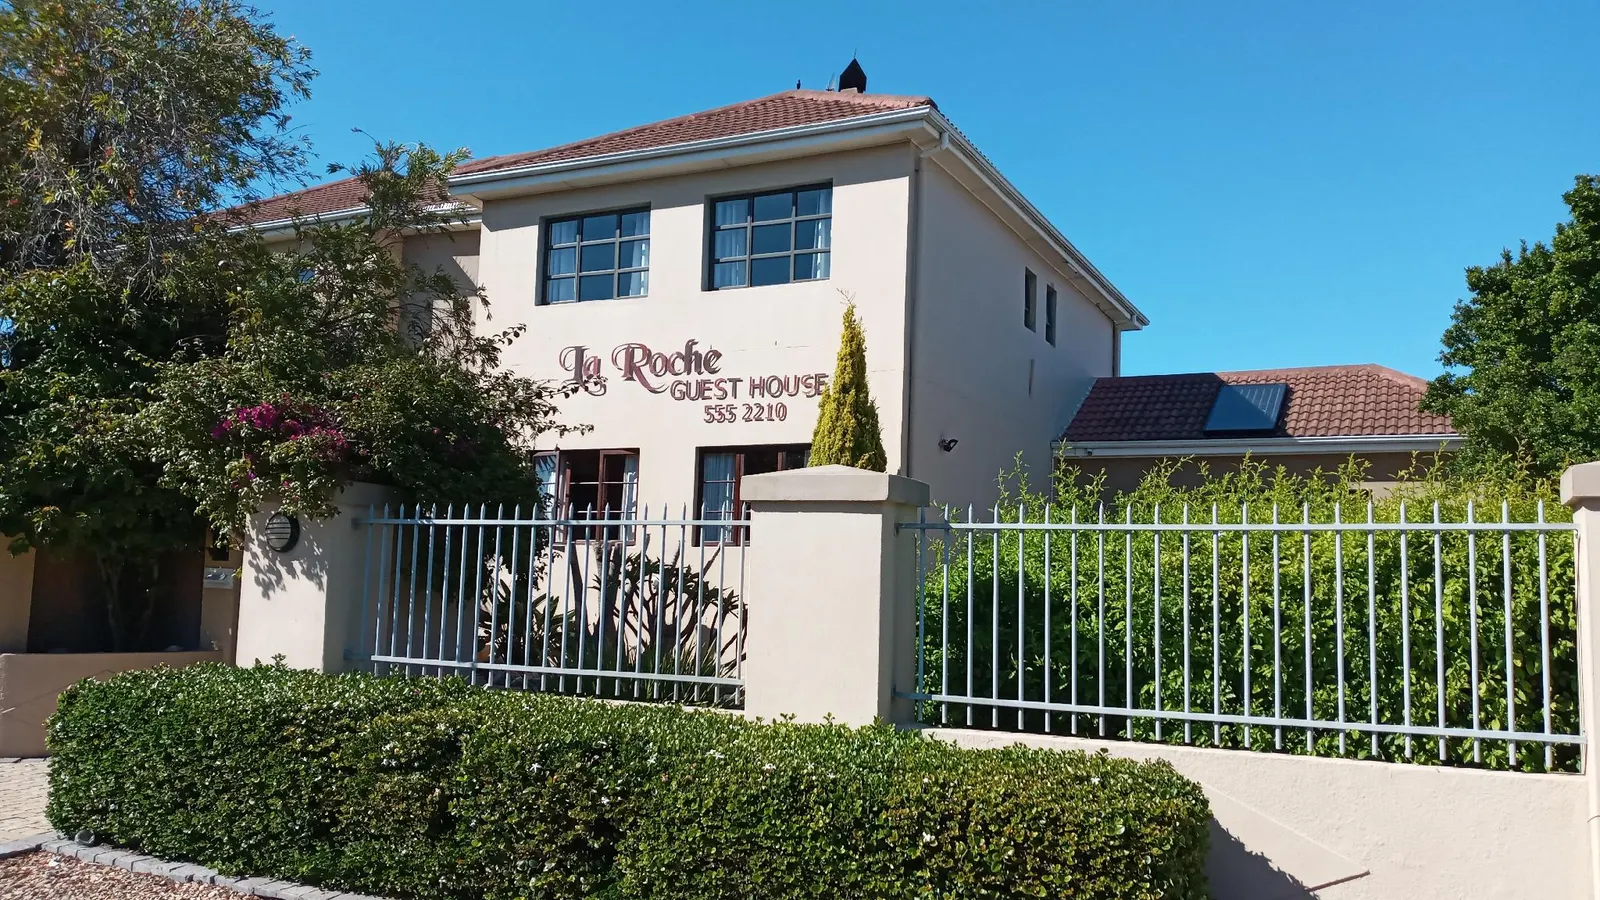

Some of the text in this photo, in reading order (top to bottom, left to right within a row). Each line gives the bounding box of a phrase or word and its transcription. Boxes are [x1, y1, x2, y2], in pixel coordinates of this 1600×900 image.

[559, 338, 722, 396] La Roche
[670, 373, 829, 401] GUEST HOUSE
[703, 402, 788, 423] 555 2210
